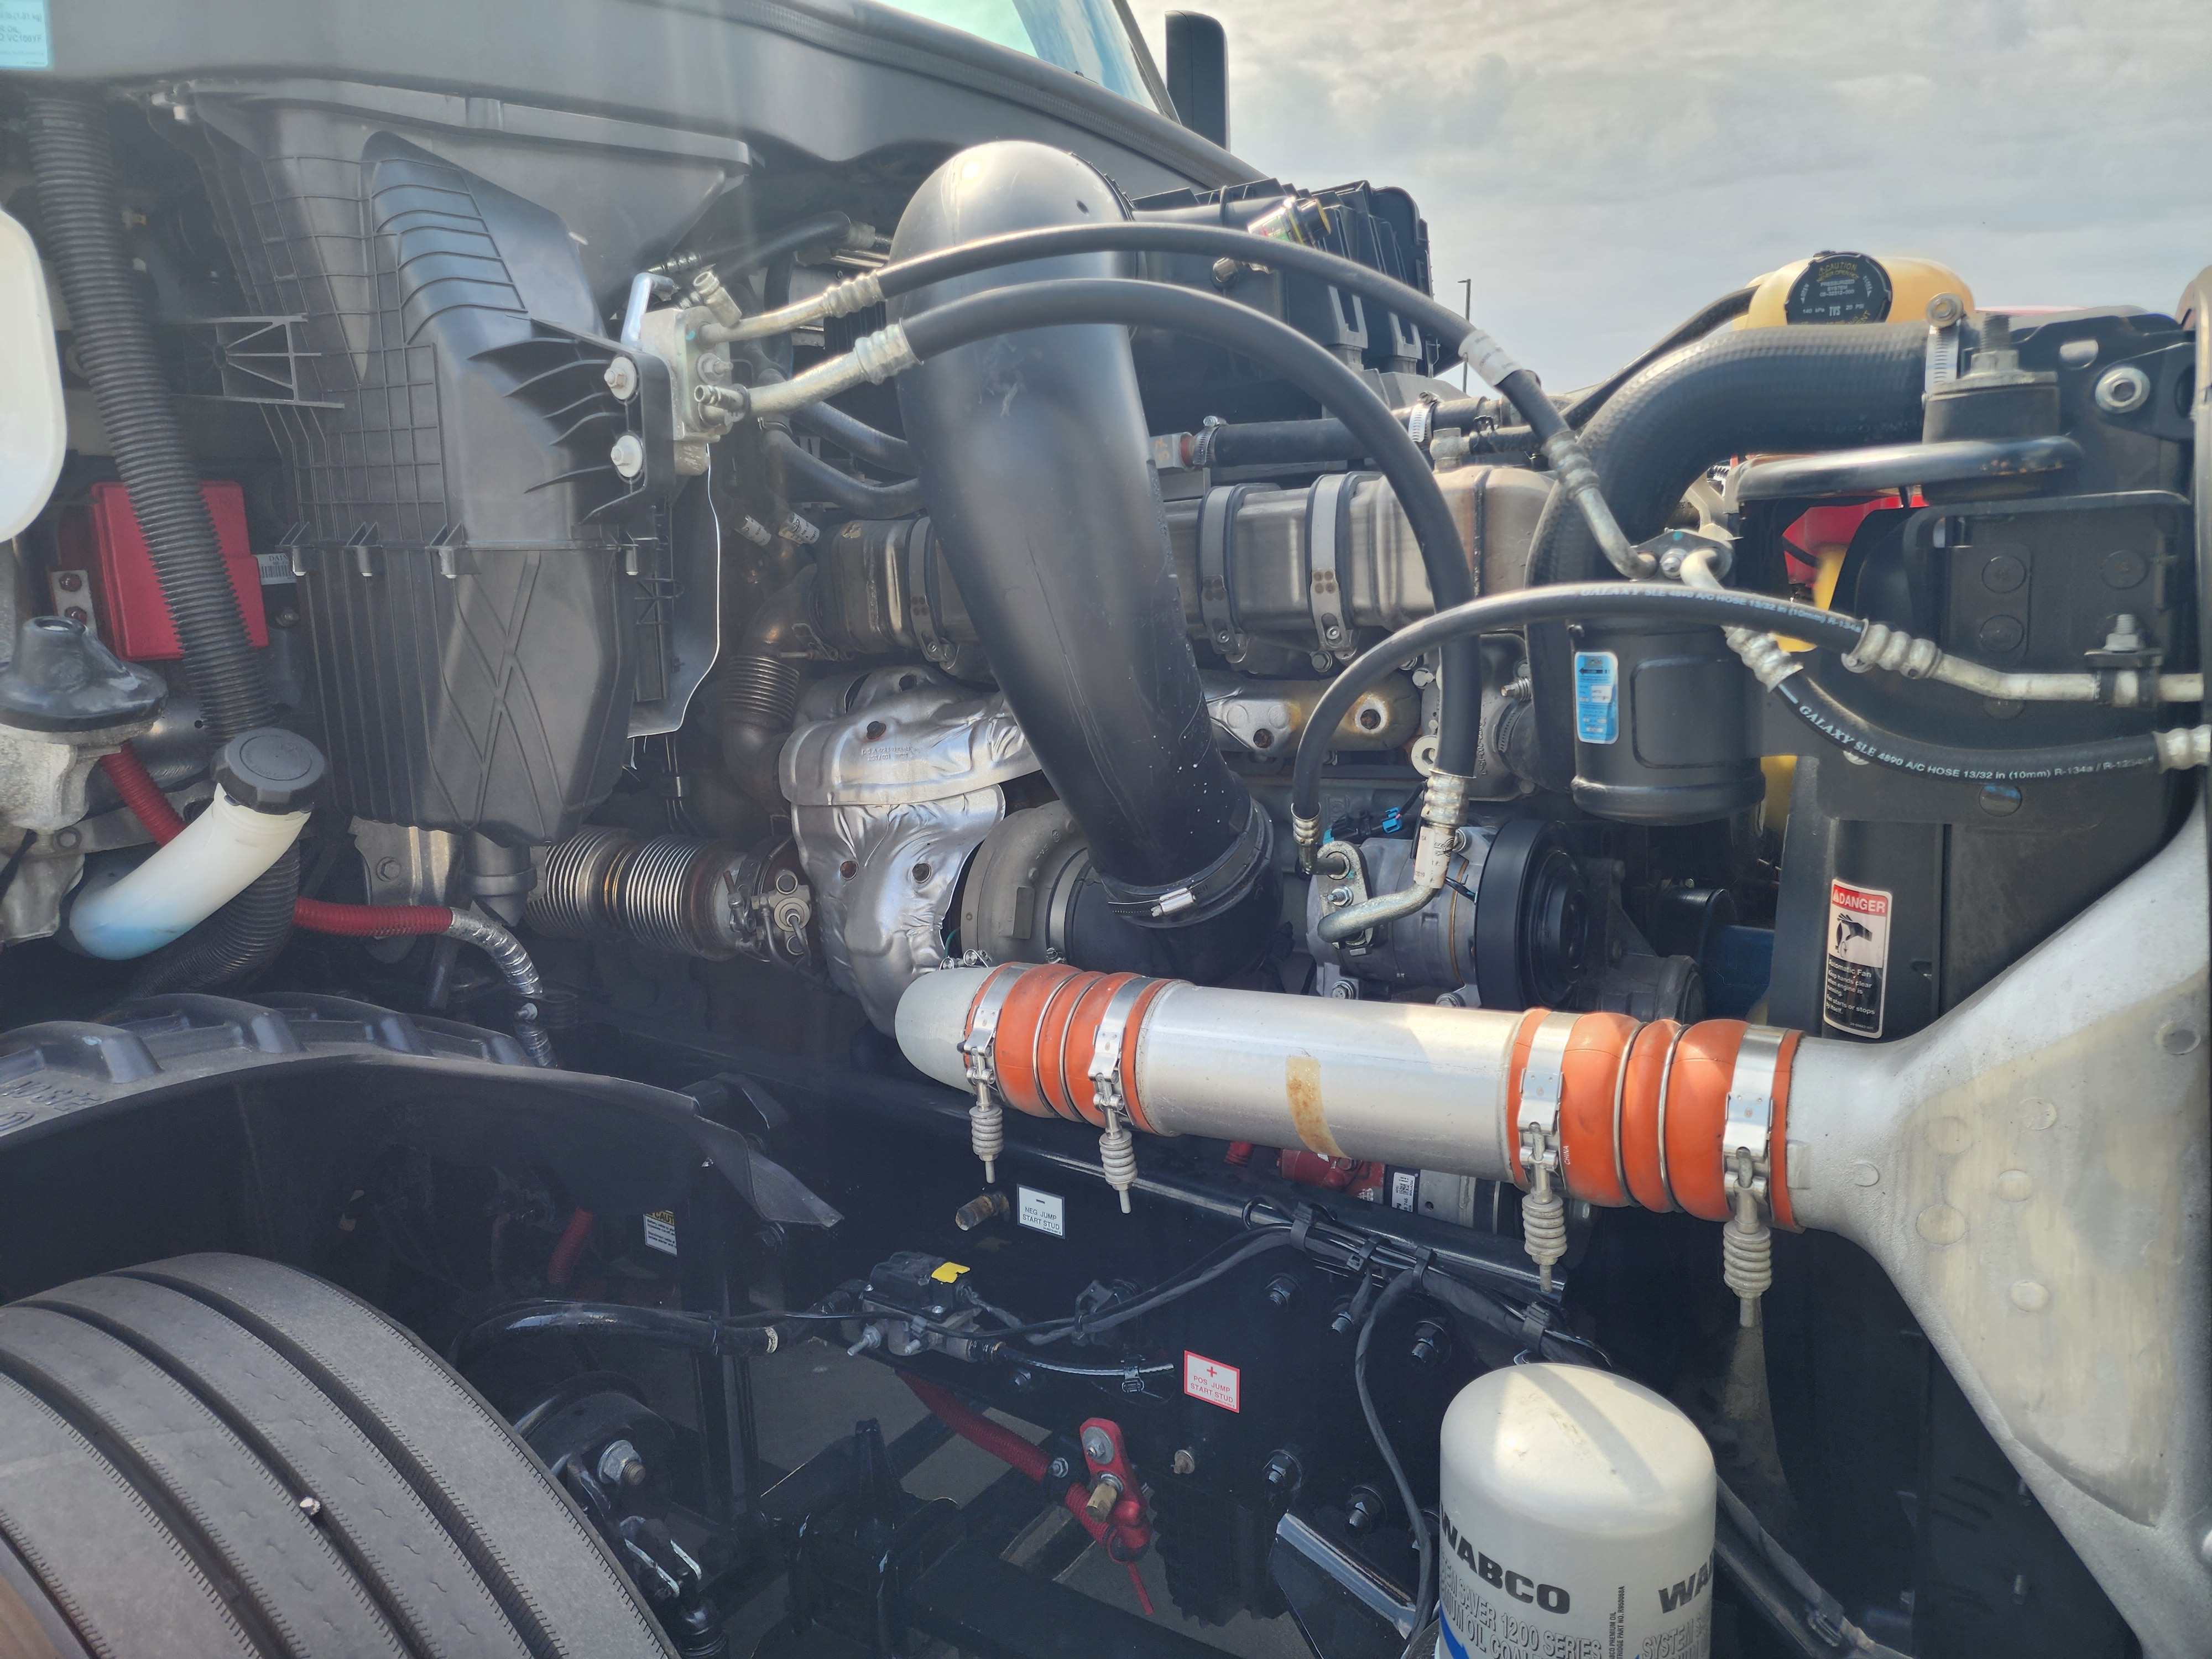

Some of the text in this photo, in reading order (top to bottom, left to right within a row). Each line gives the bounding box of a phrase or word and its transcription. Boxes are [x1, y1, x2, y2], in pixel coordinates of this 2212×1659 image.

[1825, 262, 1858, 272] CAUTION
[1829, 306, 1841, 316] TVS
[1580, 587, 1642, 596] GALAXY
[1644, 588, 1666, 597] SLE
[1717, 594, 1747, 606] HOSE
[1777, 604, 1787, 613] in
[1799, 706, 1855, 744] GALAXY
[1854, 742, 1877, 757] SLE
[1877, 753, 1904, 766] 4890
[1906, 761, 1926, 771] A/C
[1927, 766, 1960, 778] HOSE
[1964, 769, 1993, 779] 13/32
[1995, 770, 2006, 779] in
[2008, 769, 2051, 780] (10mm)
[2054, 765, 2094, 776] R-134a
[1839, 893, 1886, 913] DANGER
[1857, 969, 1872, 978] Fan
[1837, 984, 1856, 993] engine
[1833, 999, 1847, 1008] starts
[1856, 1006, 1875, 1015] stops
[1022, 1214, 1060, 1230] START STUD
[1025, 1206, 1057, 1221] NEG JUMP
[1193, 1375, 1230, 1392] POS JUMP
[1191, 1383, 1233, 1403] START STUD
[1441, 1500, 1570, 1614] WABCO
[1459, 1578, 1496, 1632] SAVER
[1501, 1613, 1539, 1651] 1200
[1542, 1630, 1601, 1659] SERIES
[1467, 1614, 1486, 1653] OIL
[1642, 1618, 1693, 1659] SYSTEM
